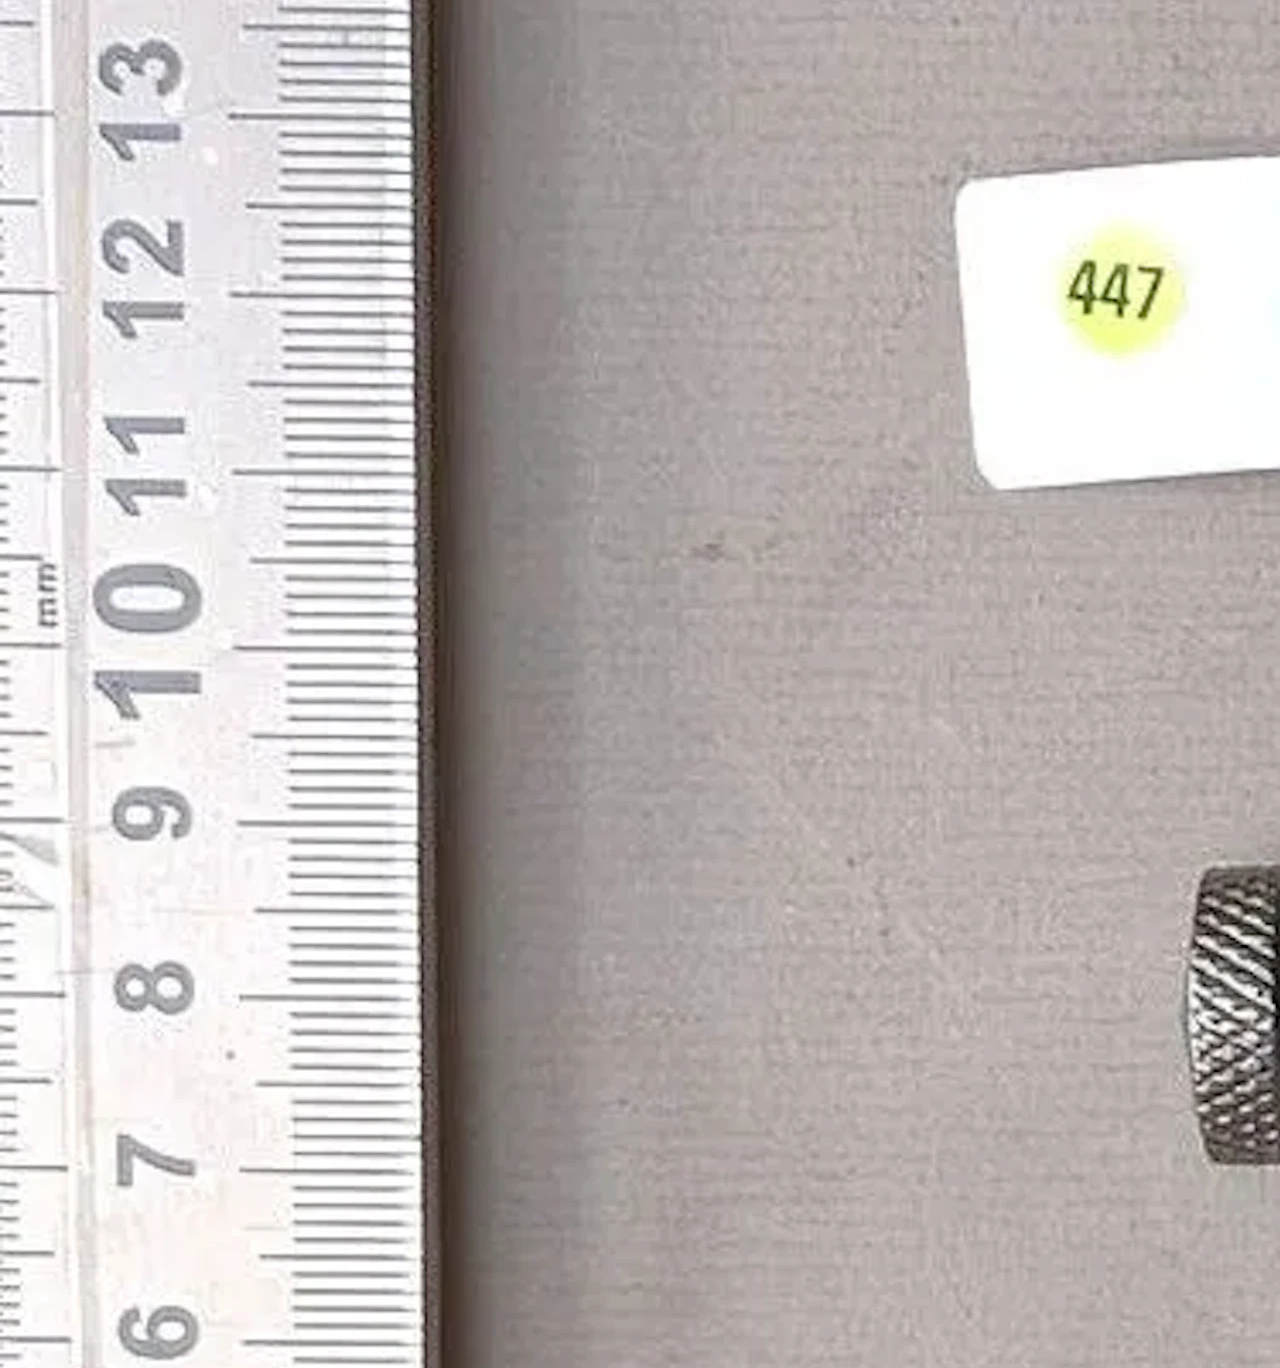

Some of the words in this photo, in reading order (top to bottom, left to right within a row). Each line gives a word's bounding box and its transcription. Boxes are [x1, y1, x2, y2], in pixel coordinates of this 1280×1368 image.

[99, 40, 181, 161] 13
[101, 220, 184, 339] 12
[1067, 260, 1165, 319] 447
[104, 417, 186, 516] 11
[93, 564, 201, 720] 10
[112, 787, 191, 840] 9
[113, 961, 194, 1015] 8
[117, 1134, 195, 1187] 7
[118, 1306, 198, 1360] 6
